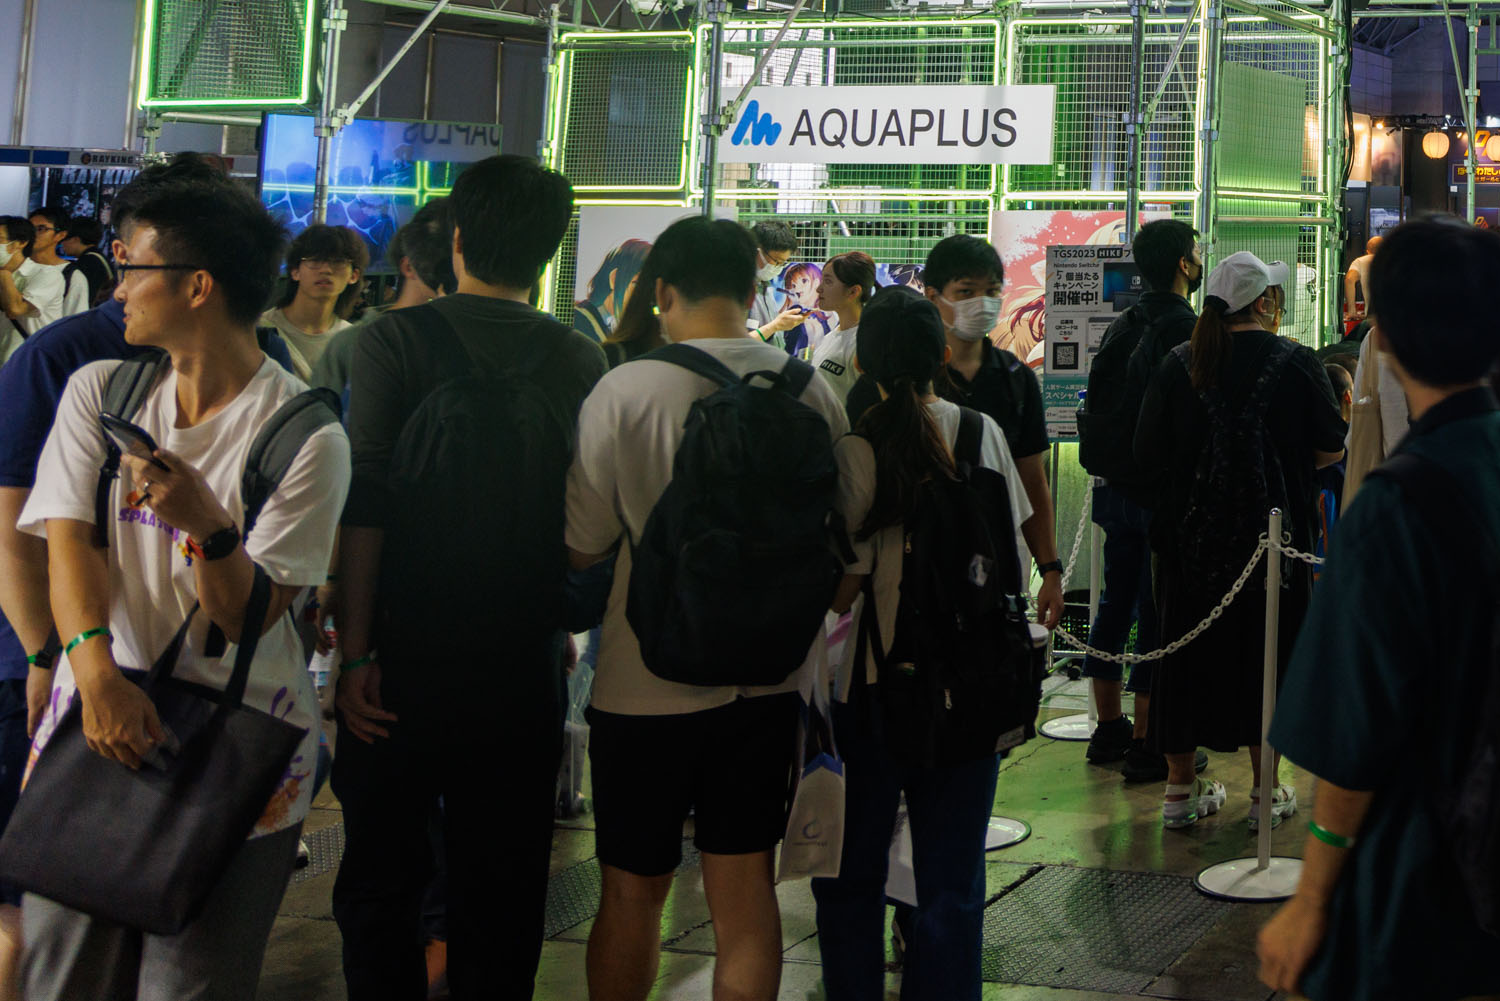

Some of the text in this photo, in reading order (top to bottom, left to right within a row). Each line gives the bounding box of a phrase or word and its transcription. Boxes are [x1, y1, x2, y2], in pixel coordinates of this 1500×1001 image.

[788, 108, 1017, 149] AQUAPLUS
[92, 155, 134, 164] RAYKING
[1053, 250, 1095, 258] TGS2023
[1099, 249, 1121, 257] HIKE
[1053, 282, 1099, 290] キャンペーン
